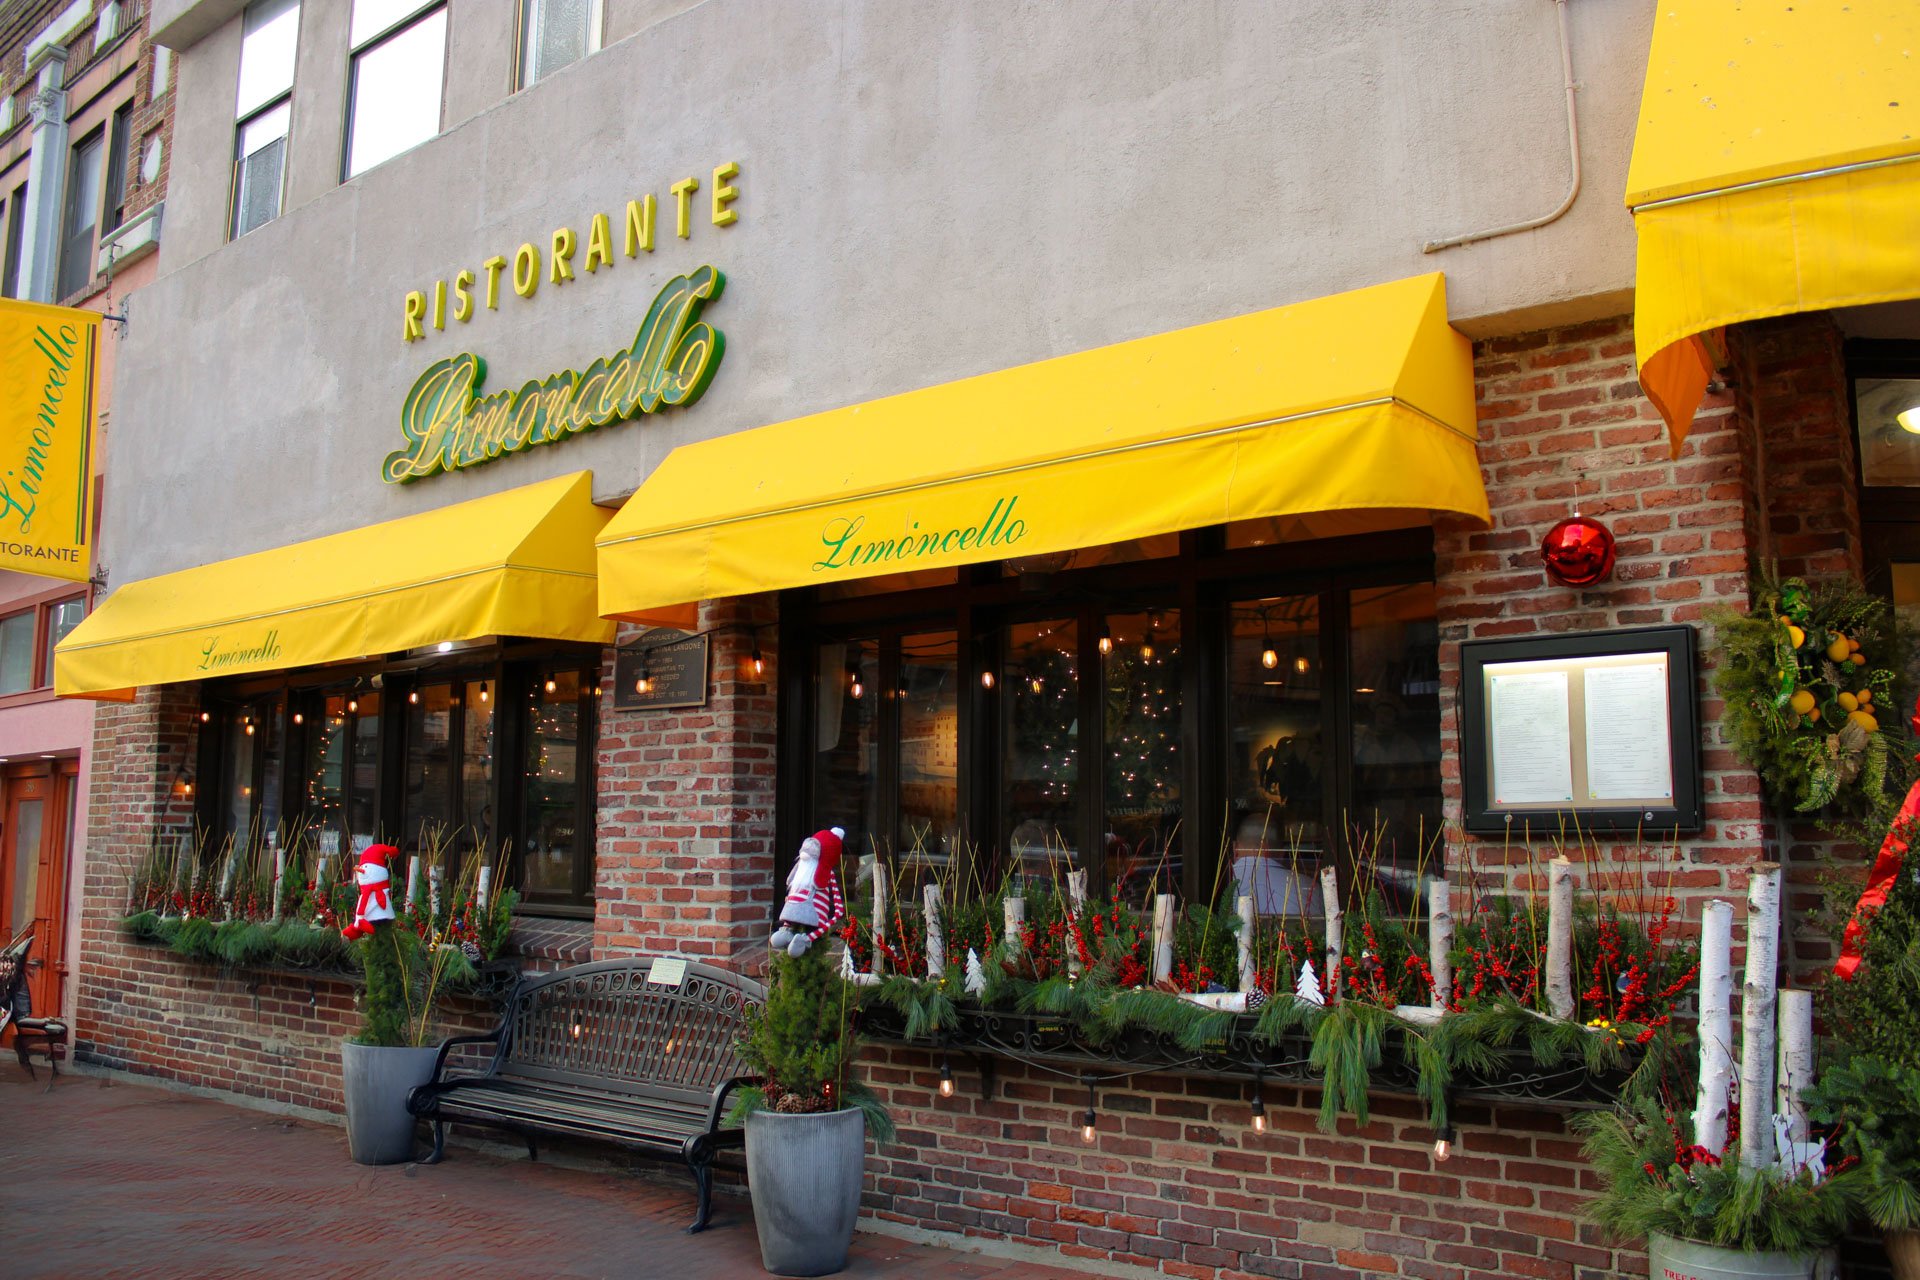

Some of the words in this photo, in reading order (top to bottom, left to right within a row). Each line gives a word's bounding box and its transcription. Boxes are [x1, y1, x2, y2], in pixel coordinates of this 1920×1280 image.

[403, 161, 740, 342] RISTORANTE
[0, 322, 78, 534] Limoncello
[381, 264, 726, 484] Limoncello
[811, 495, 1029, 573] Limoncello
[196, 629, 282, 672] Limoncello
